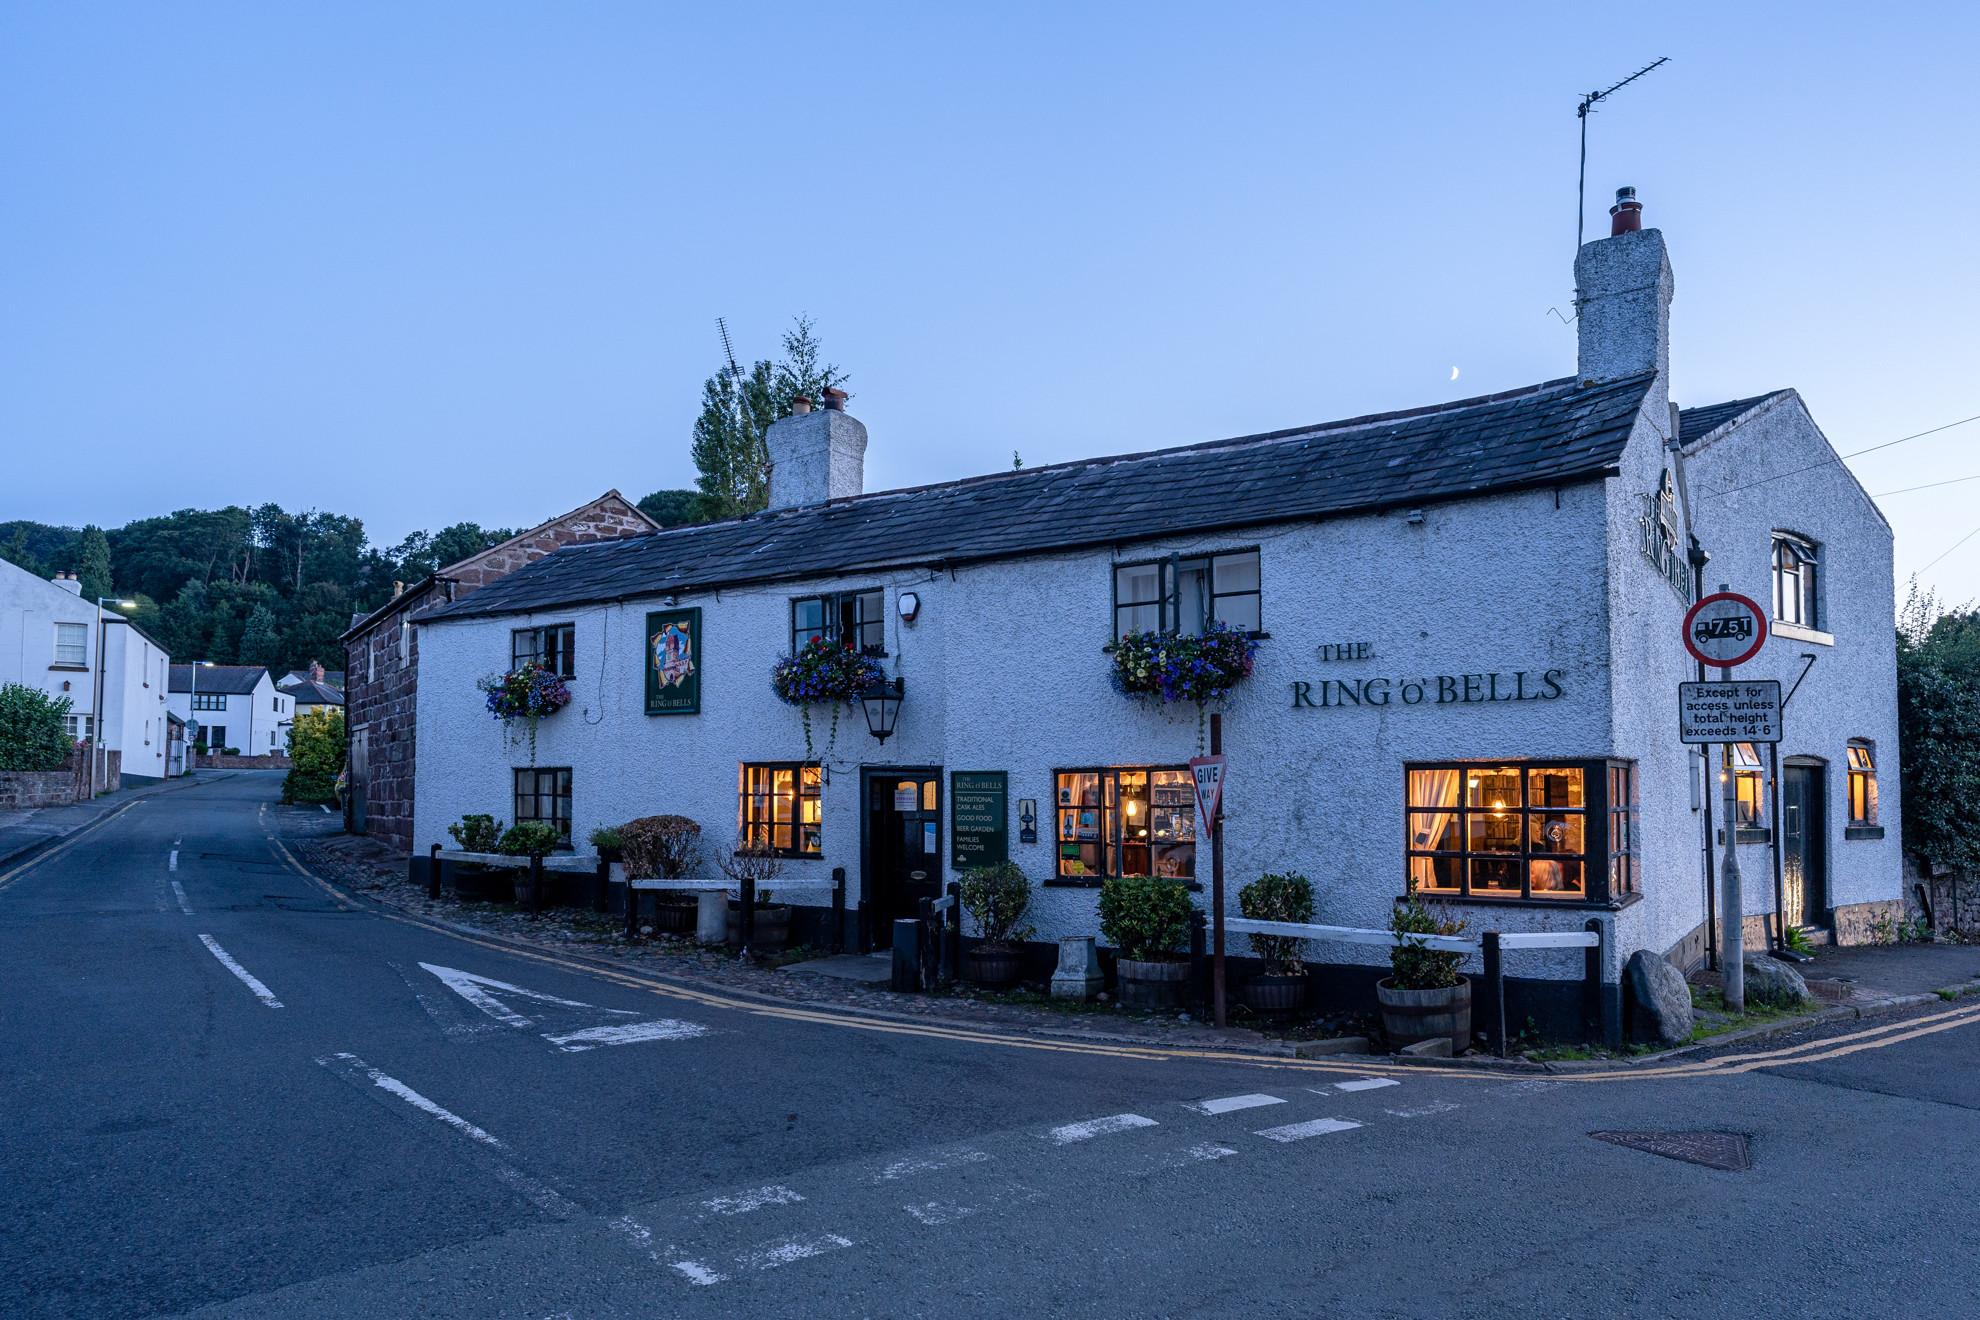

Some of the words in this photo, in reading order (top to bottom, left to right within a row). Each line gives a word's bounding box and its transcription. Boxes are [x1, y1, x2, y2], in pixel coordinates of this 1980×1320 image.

[1318, 642, 1371, 662] THE
[1291, 678, 1390, 708] RING
[1435, 669, 1563, 704] BELLS
[1696, 688, 1740, 699] Except
[1746, 687, 1763, 698] for
[650, 699, 667, 708] RING
[672, 698, 692, 707] BELLS
[1686, 702, 1729, 711] access
[1734, 700, 1774, 710] unless
[1694, 713, 1724, 724] total
[1729, 712, 1769, 725] height
[1686, 726, 1737, 736] exceeds
[1197, 767, 1218, 784] GIVE
[981, 781, 1002, 789] BELLS
[1200, 788, 1215, 800] WAY
